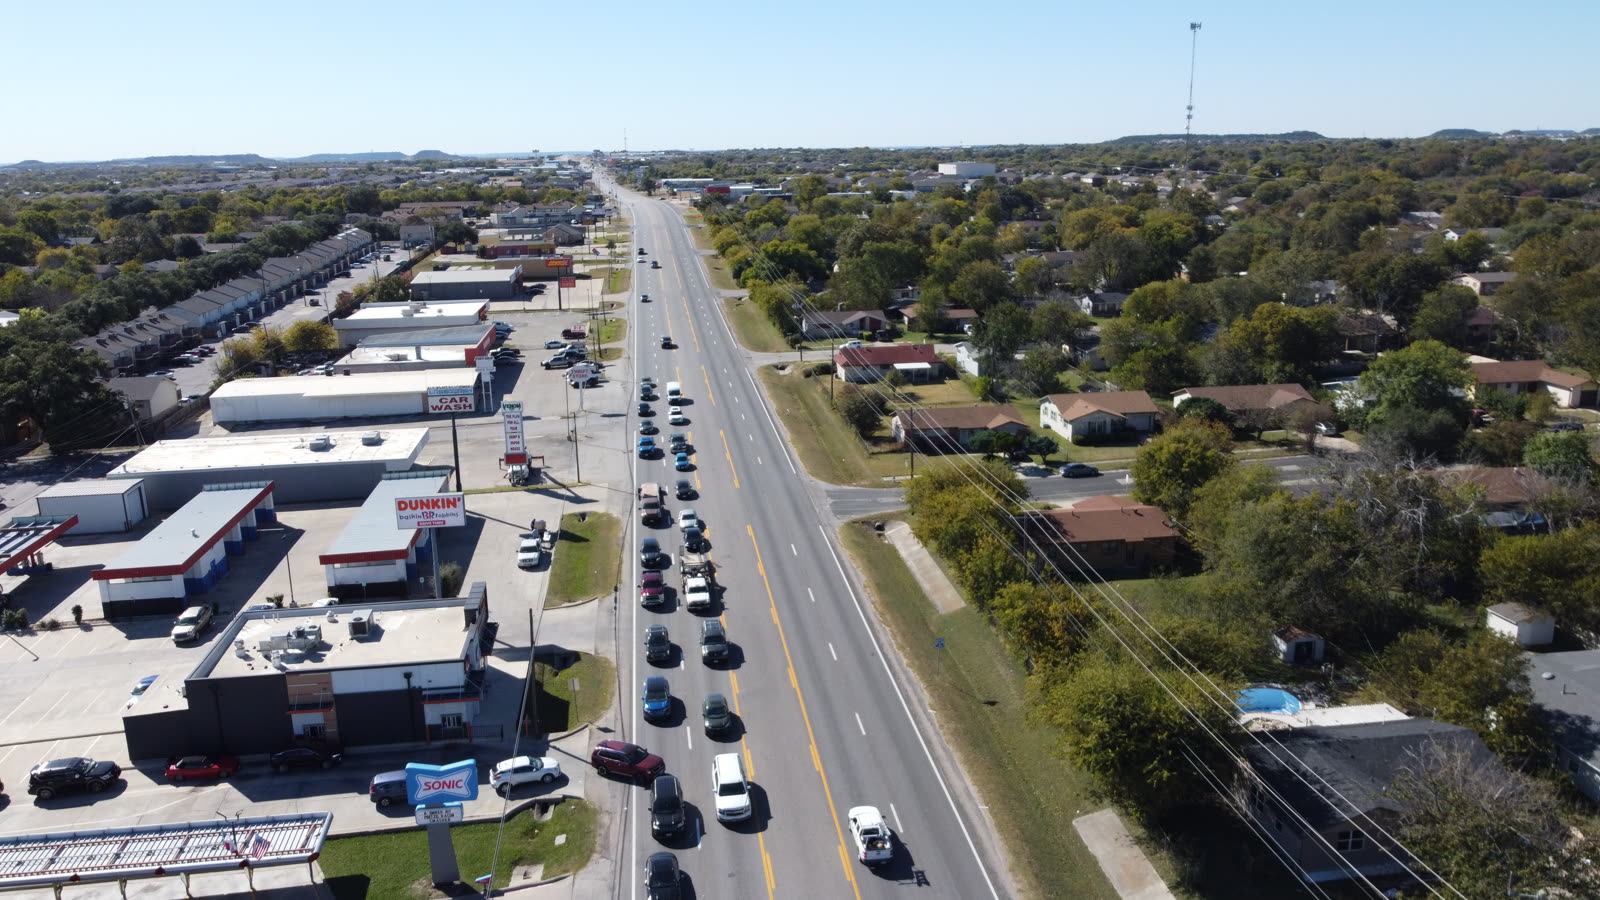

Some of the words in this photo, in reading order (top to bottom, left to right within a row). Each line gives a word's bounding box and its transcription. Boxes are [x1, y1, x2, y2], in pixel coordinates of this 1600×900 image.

[503, 402, 521, 410] VENOM
[397, 497, 461, 511] DUNKIN'
[423, 779, 464, 791] SONIC
